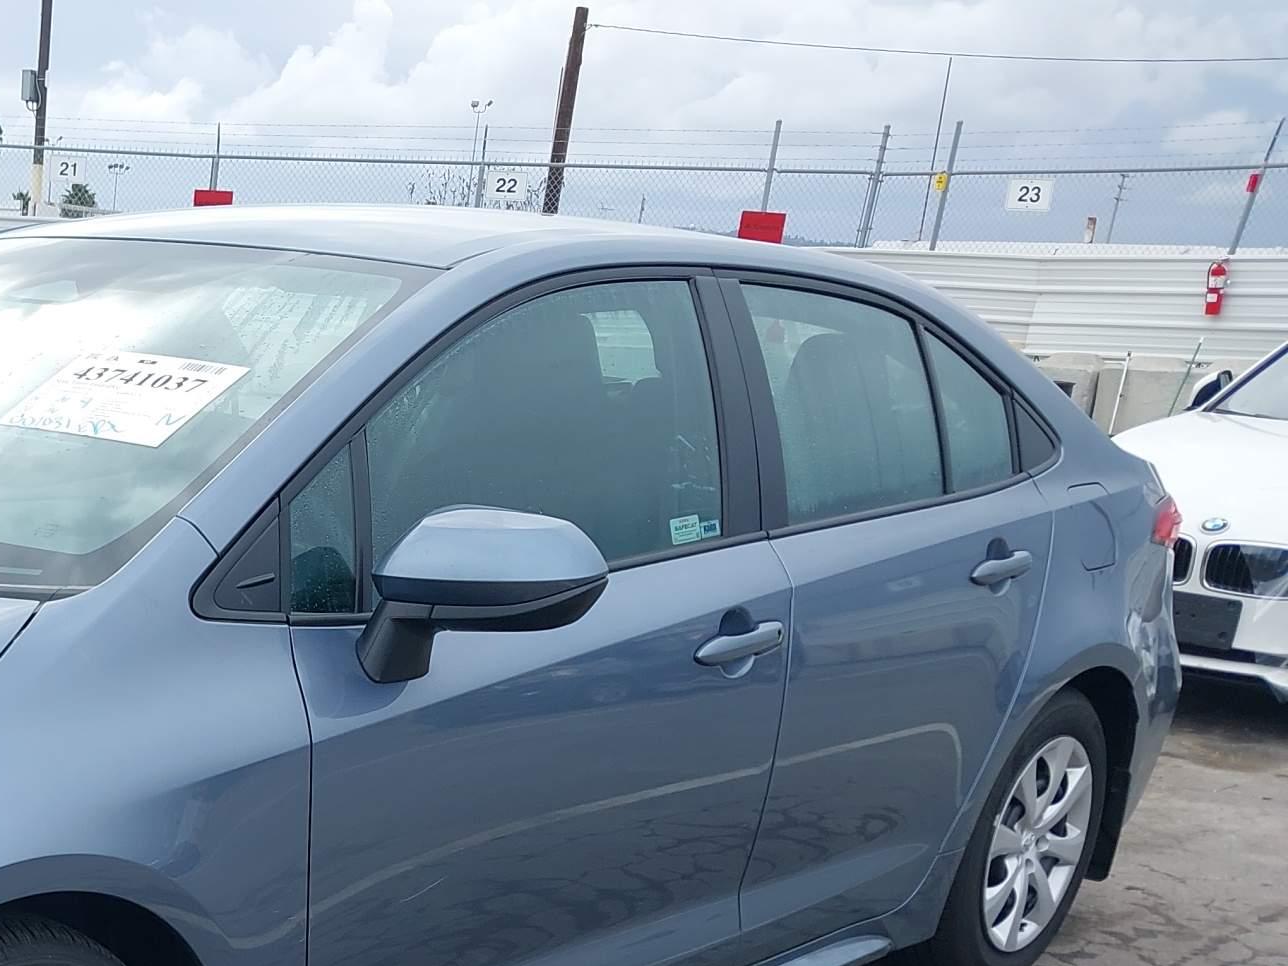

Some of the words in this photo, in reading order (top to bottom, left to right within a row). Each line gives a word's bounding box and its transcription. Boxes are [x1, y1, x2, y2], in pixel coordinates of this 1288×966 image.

[59, 162, 77, 176] 21
[495, 177, 518, 193] 22
[1017, 185, 1041, 203] 23
[73, 366, 208, 393] 43741037
